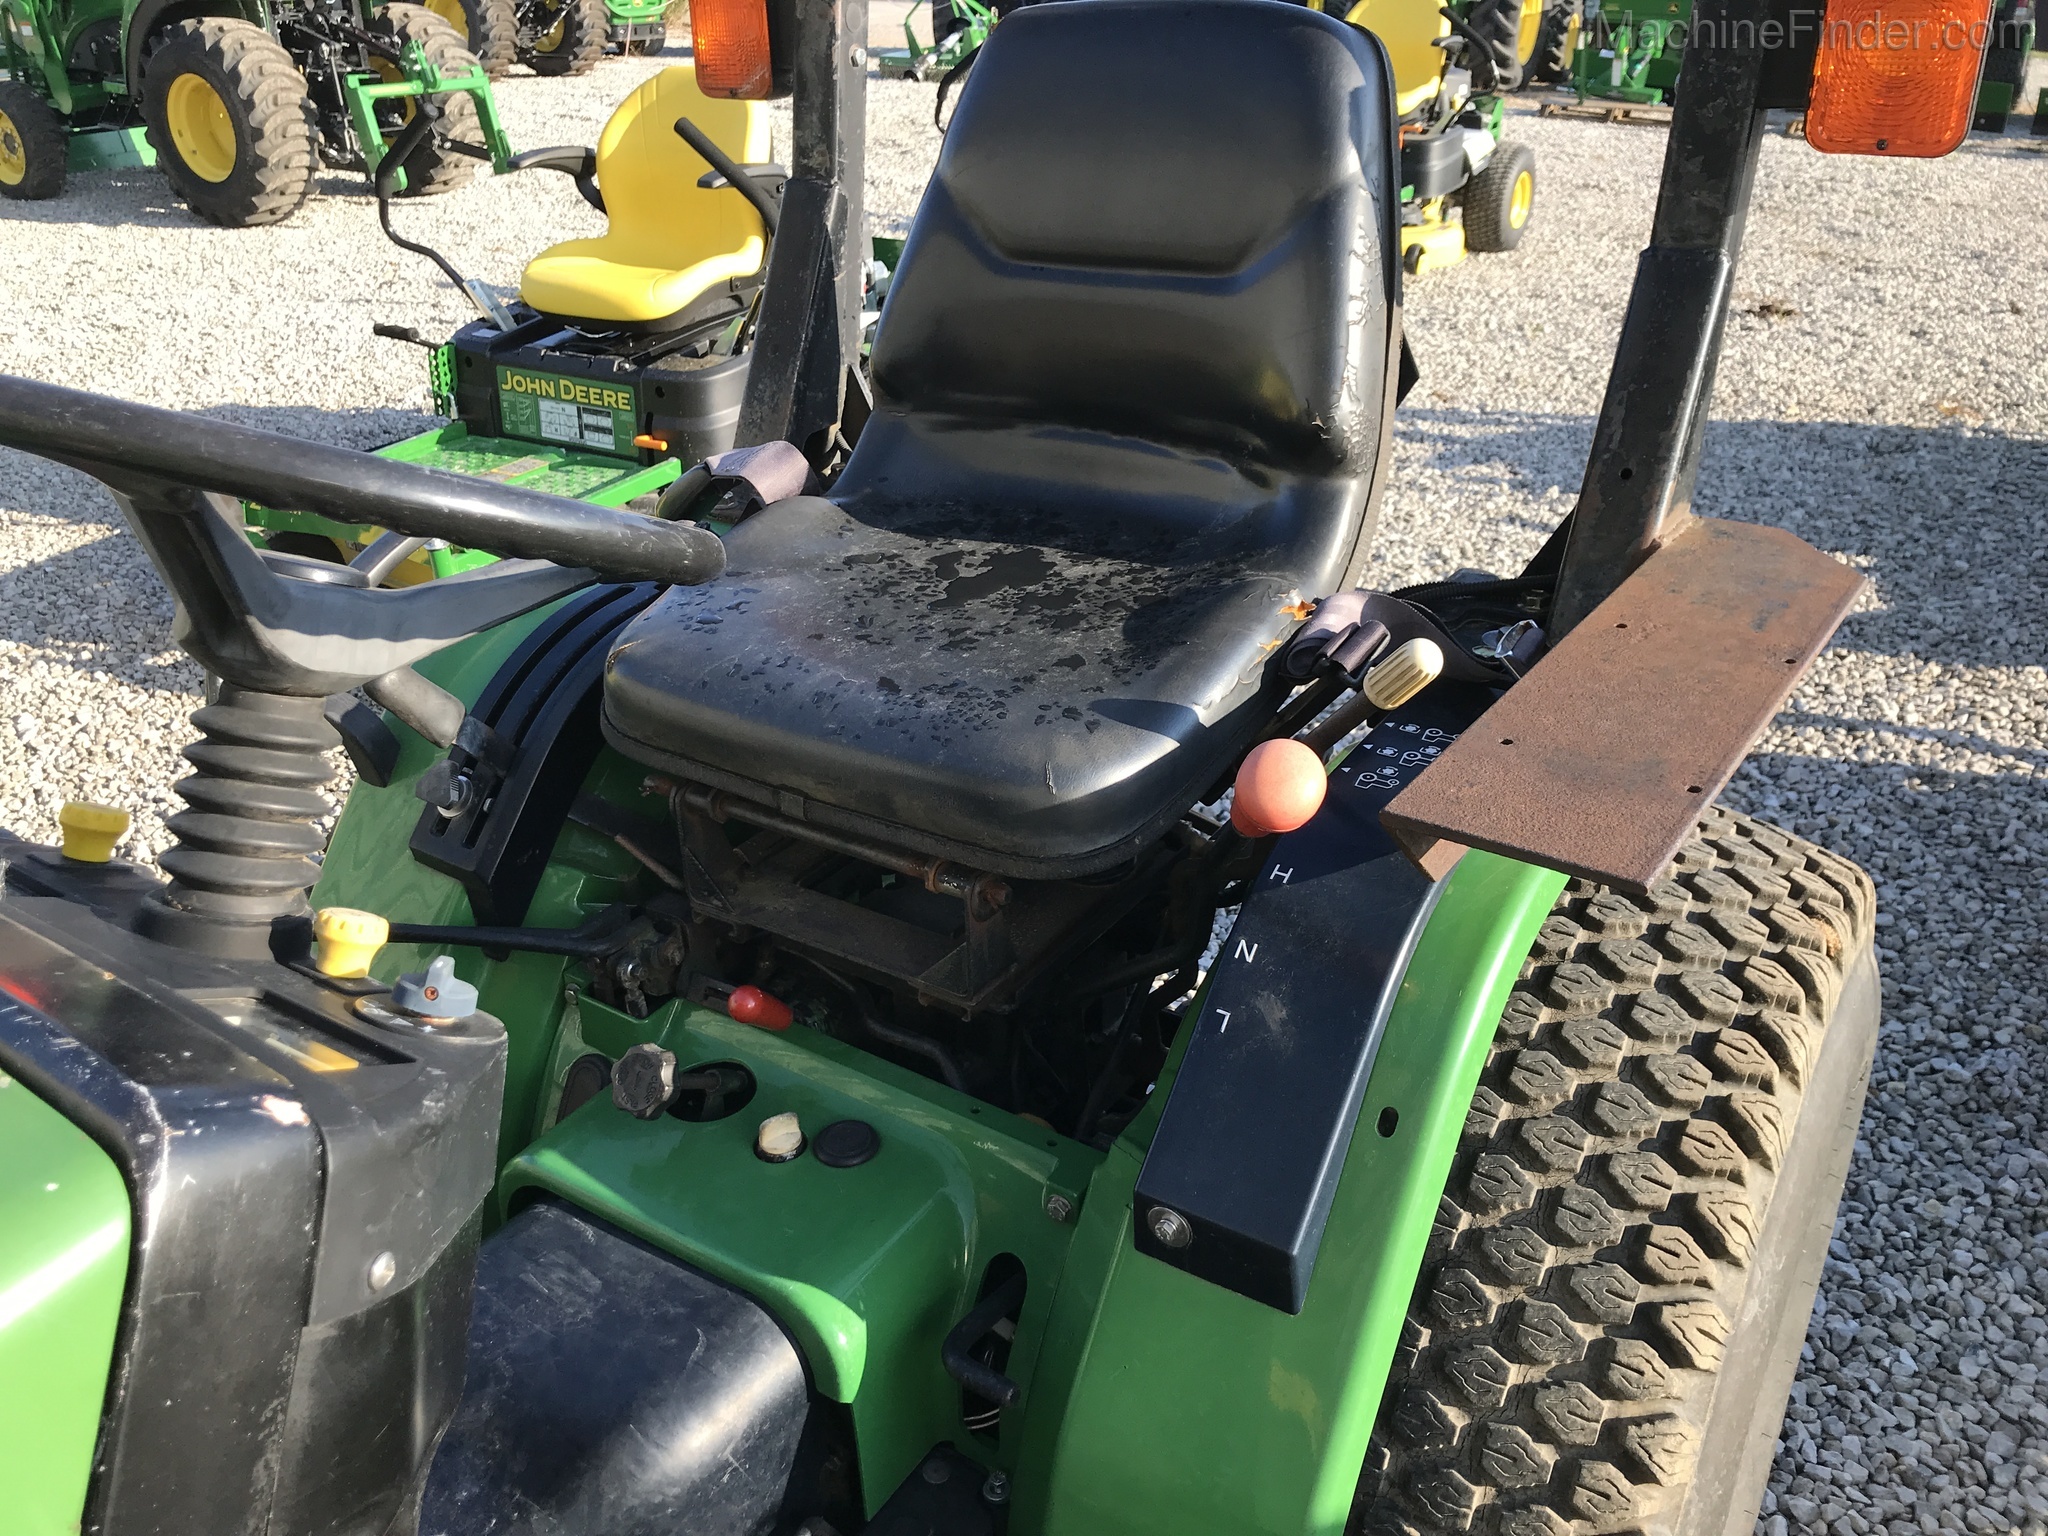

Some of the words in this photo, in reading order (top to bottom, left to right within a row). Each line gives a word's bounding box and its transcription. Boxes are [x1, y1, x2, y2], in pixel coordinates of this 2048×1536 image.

[501, 370, 556, 398] JOHN
[559, 379, 631, 411] DEERE
[1269, 864, 1294, 884] H
[1234, 939, 1258, 963] N
[1216, 1008, 1231, 1034] L
